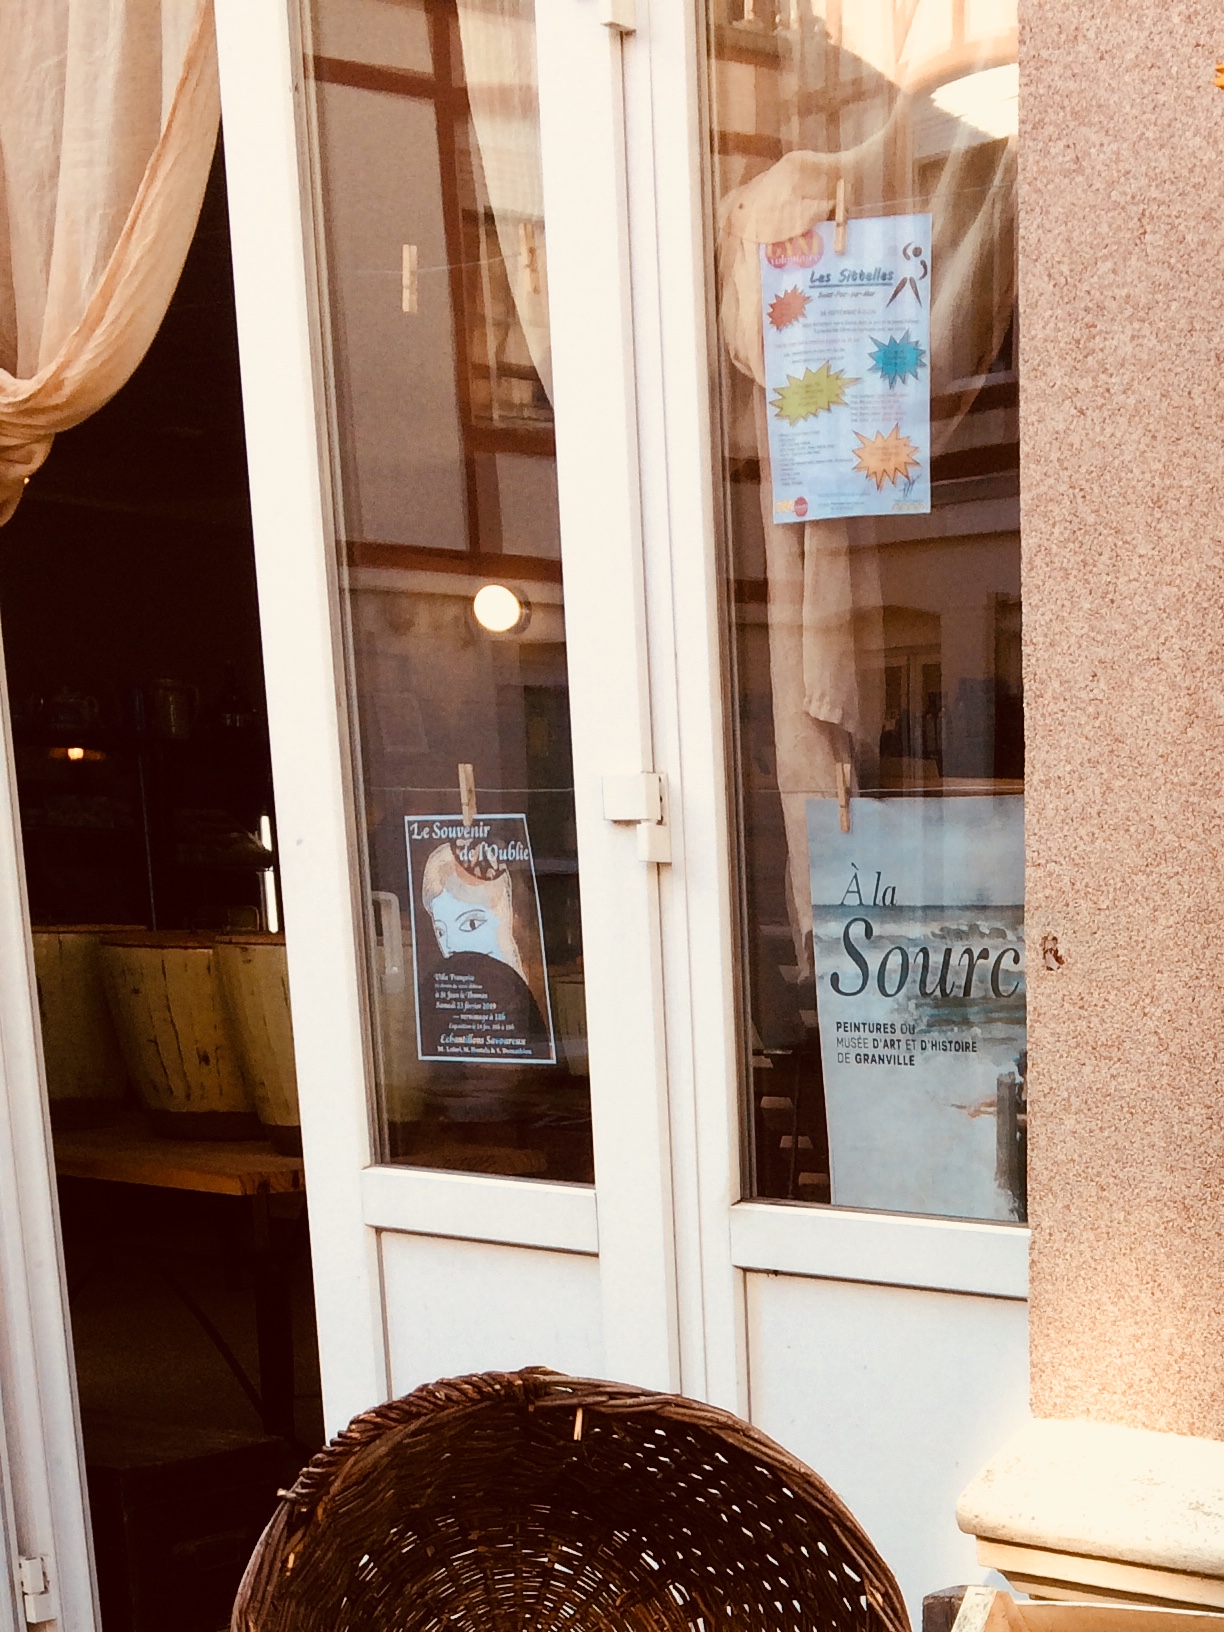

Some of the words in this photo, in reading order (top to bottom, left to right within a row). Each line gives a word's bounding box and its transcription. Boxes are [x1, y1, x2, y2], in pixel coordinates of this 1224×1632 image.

[809, 270, 832, 284] Les
[839, 268, 894, 283] Sittelles
[410, 822, 430, 840] Le
[432, 821, 491, 840] Souvenir
[460, 843, 474, 861] de
[839, 862, 865, 906] À
[873, 871, 897, 907] la
[836, 1021, 897, 1035] PEINTURES
[900, 1023, 916, 1035] DU
[836, 1036, 869, 1049] MUSÉE
[872, 1038, 901, 1050] D'ART
[905, 1039, 916, 1050] ET
[920, 1039, 978, 1053] D'HISTOIRE
[837, 1052, 851, 1064] DE
[855, 1053, 916, 1067] GRANVILLE
